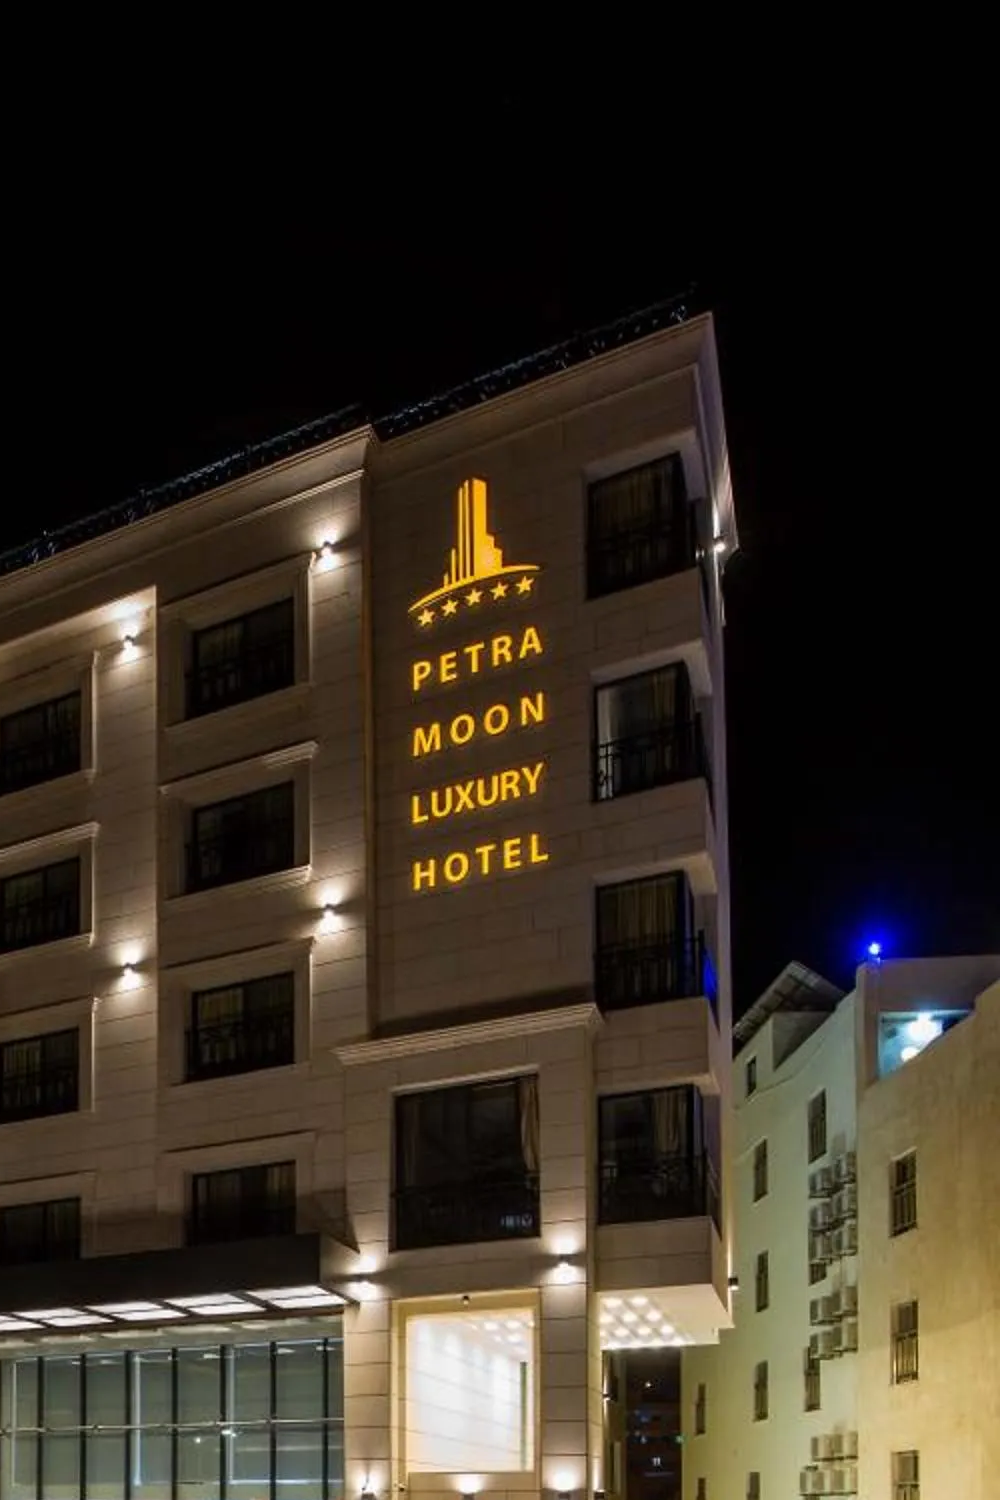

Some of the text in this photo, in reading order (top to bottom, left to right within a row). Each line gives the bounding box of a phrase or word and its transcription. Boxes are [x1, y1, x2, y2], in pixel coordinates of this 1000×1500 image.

[412, 626, 543, 691] PETRA
[412, 692, 545, 757] MOON
[411, 763, 545, 824] LUXURY
[412, 833, 550, 890] HOTEL
